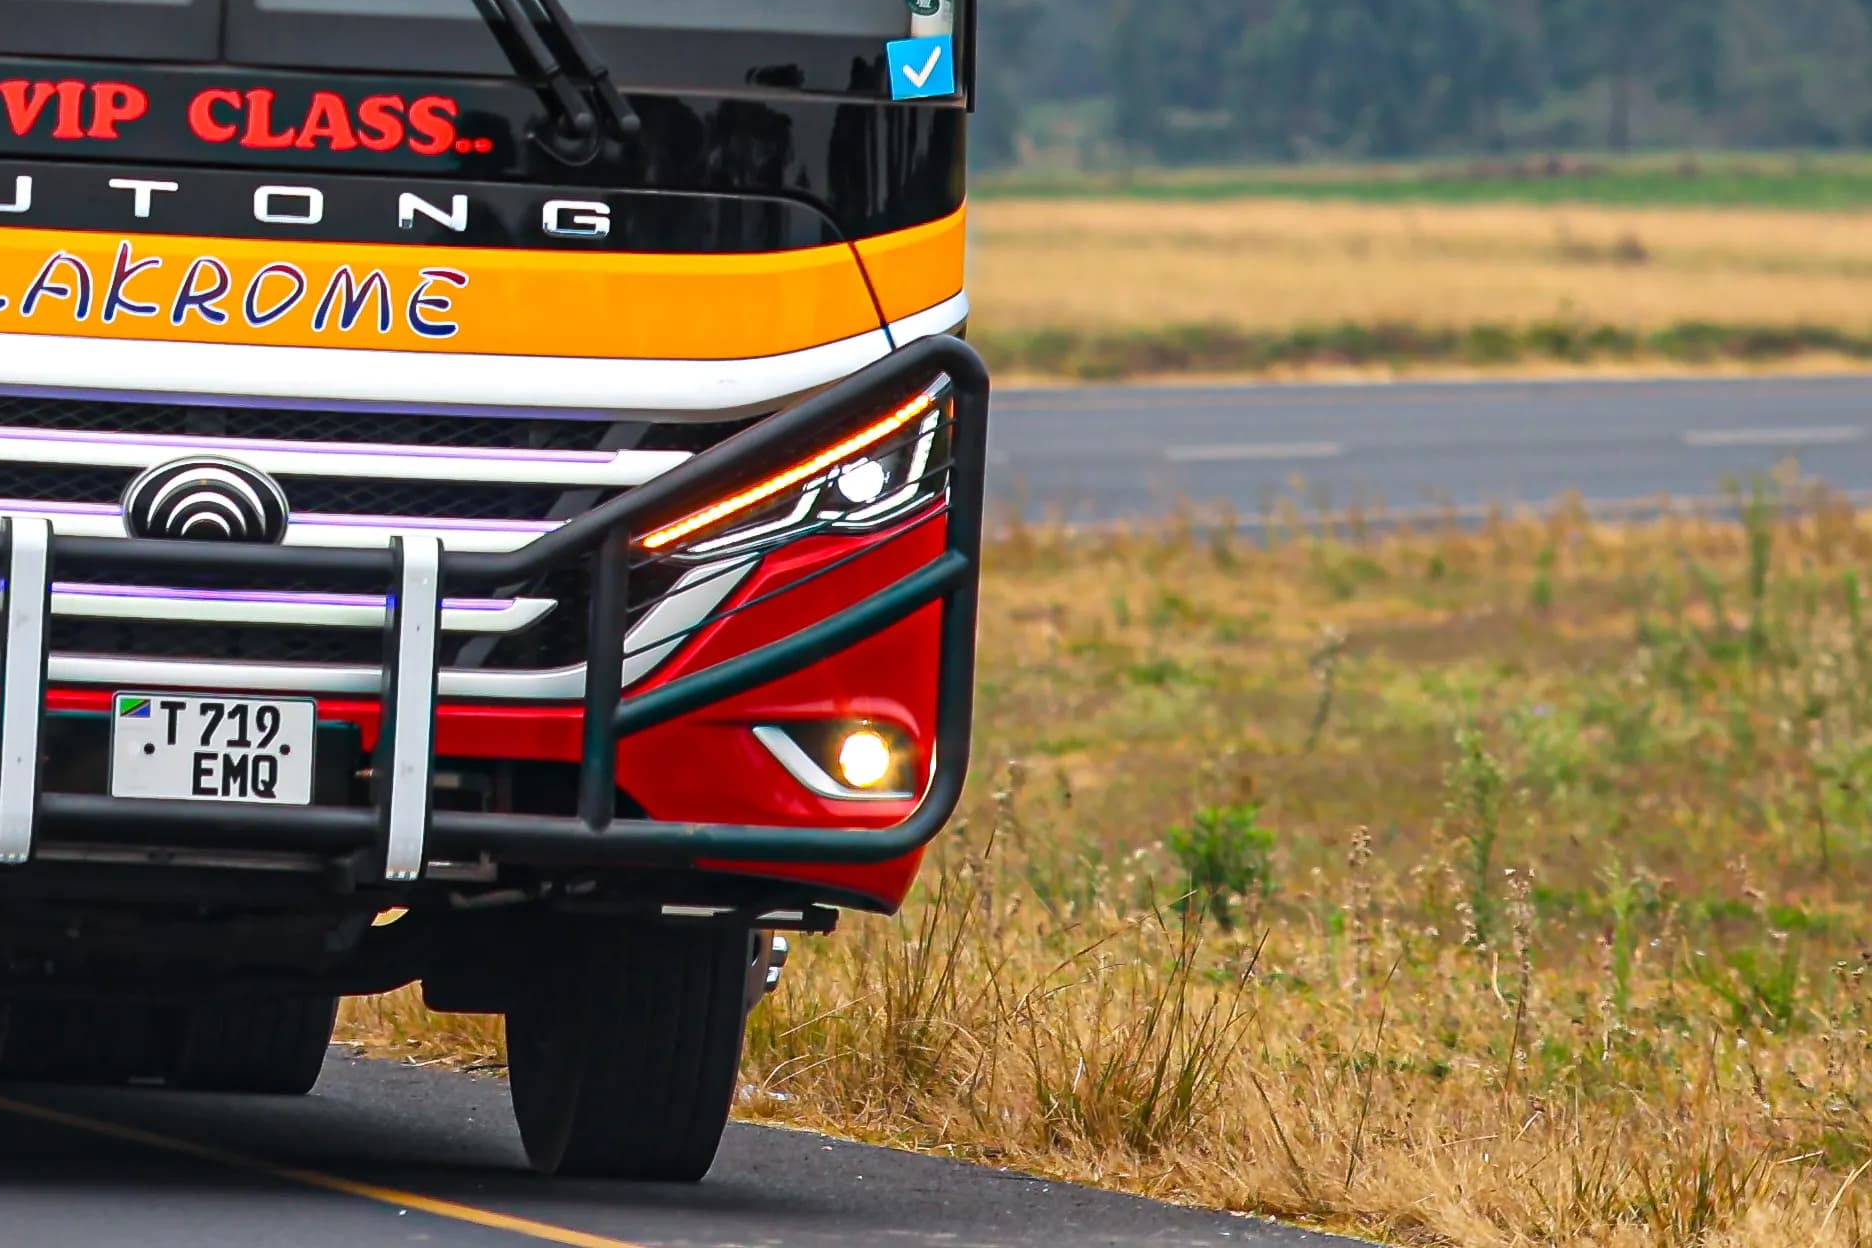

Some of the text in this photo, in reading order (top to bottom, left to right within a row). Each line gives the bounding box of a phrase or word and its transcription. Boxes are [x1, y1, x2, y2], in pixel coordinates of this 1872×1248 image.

[160, 701, 281, 749] T 719
[192, 752, 277, 799] EMQ
